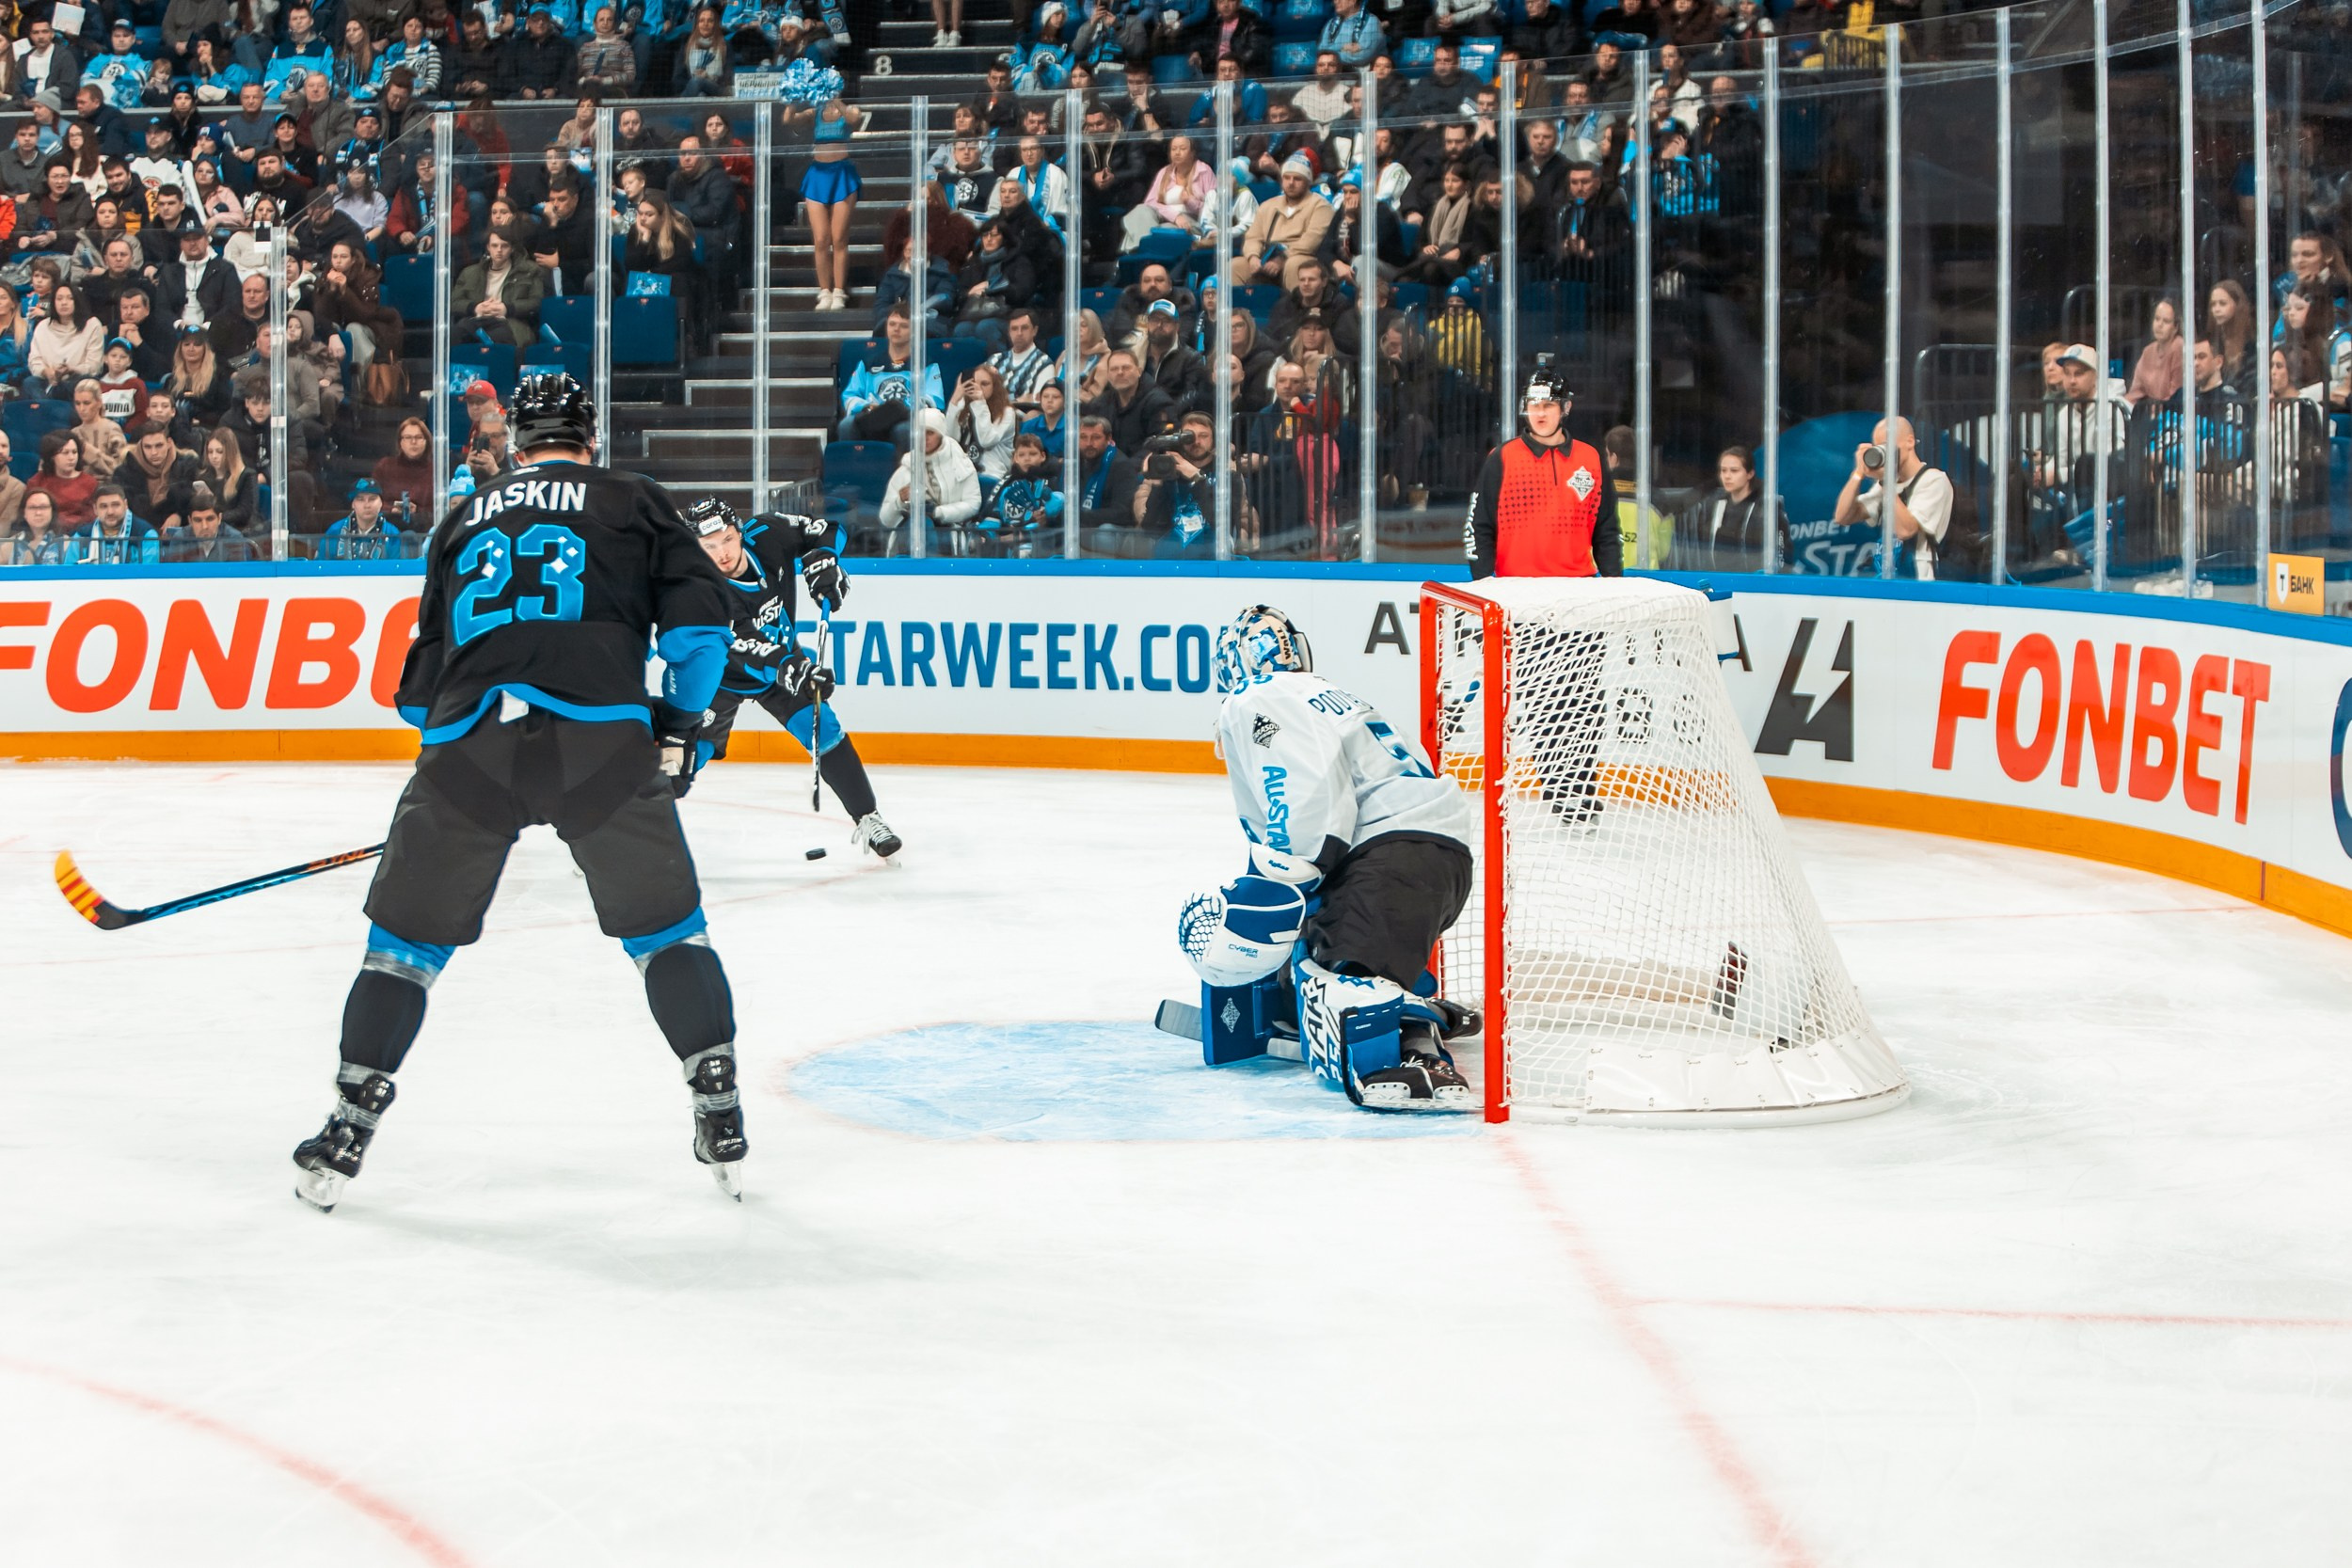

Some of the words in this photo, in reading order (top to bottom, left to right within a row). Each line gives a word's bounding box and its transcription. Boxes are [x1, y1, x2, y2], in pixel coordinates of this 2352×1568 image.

[875, 55, 892, 75] 8
[859, 111, 872, 132] 7
[465, 480, 587, 527] JASKIN
[453, 523, 587, 647] 23
[2290, 575, 2315, 595] БАНК
[795, 620, 1229, 694] STARWEEK.CO
[1931, 628, 2272, 826] FONBET
[1228, 943, 1260, 956] CYBER
